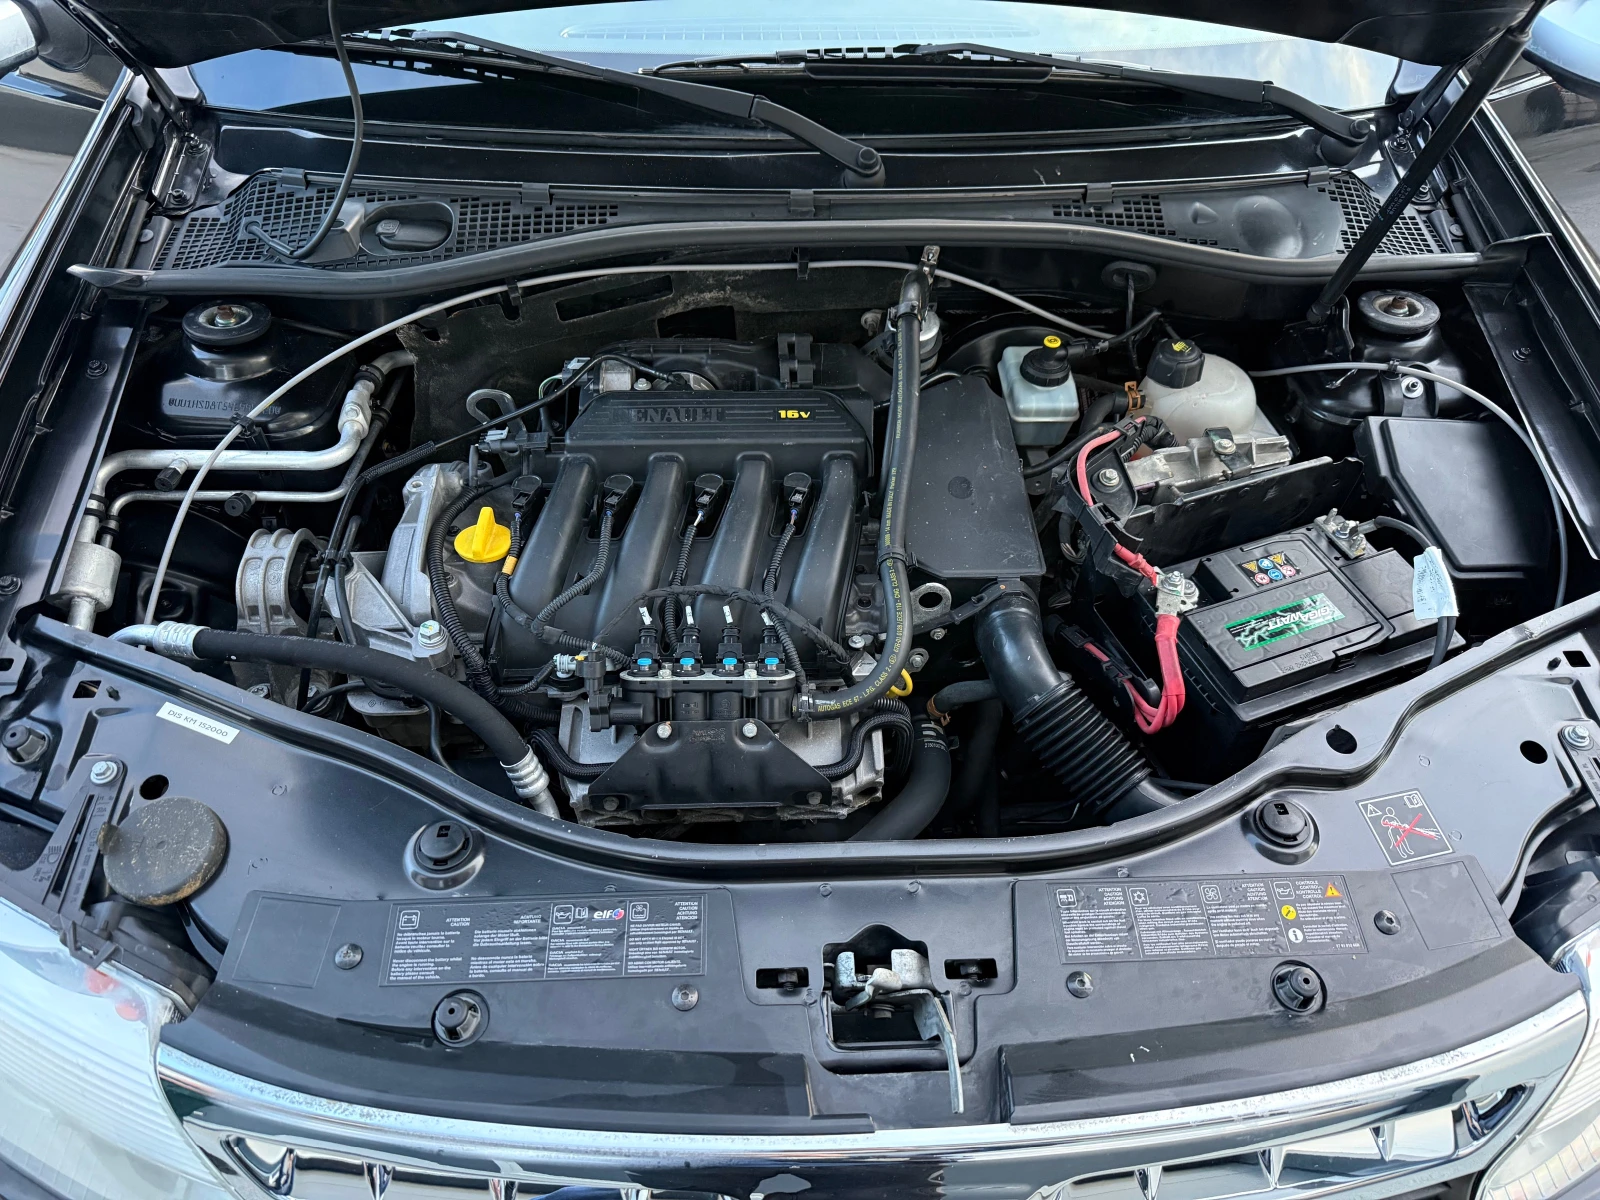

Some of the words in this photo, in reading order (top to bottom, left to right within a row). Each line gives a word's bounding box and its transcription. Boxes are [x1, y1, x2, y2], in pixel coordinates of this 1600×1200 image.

[613, 408, 722, 422] ENAULT
[818, 703, 841, 712] AUTOGAS
[843, 699, 853, 707] ECE
[874, 671, 888, 687] CLASS
[890, 572, 898, 587] CLASS
[168, 710, 182, 719] DIS
[183, 716, 197, 725] KM
[198, 722, 228, 737] 152000
[594, 910, 613, 919] elf
